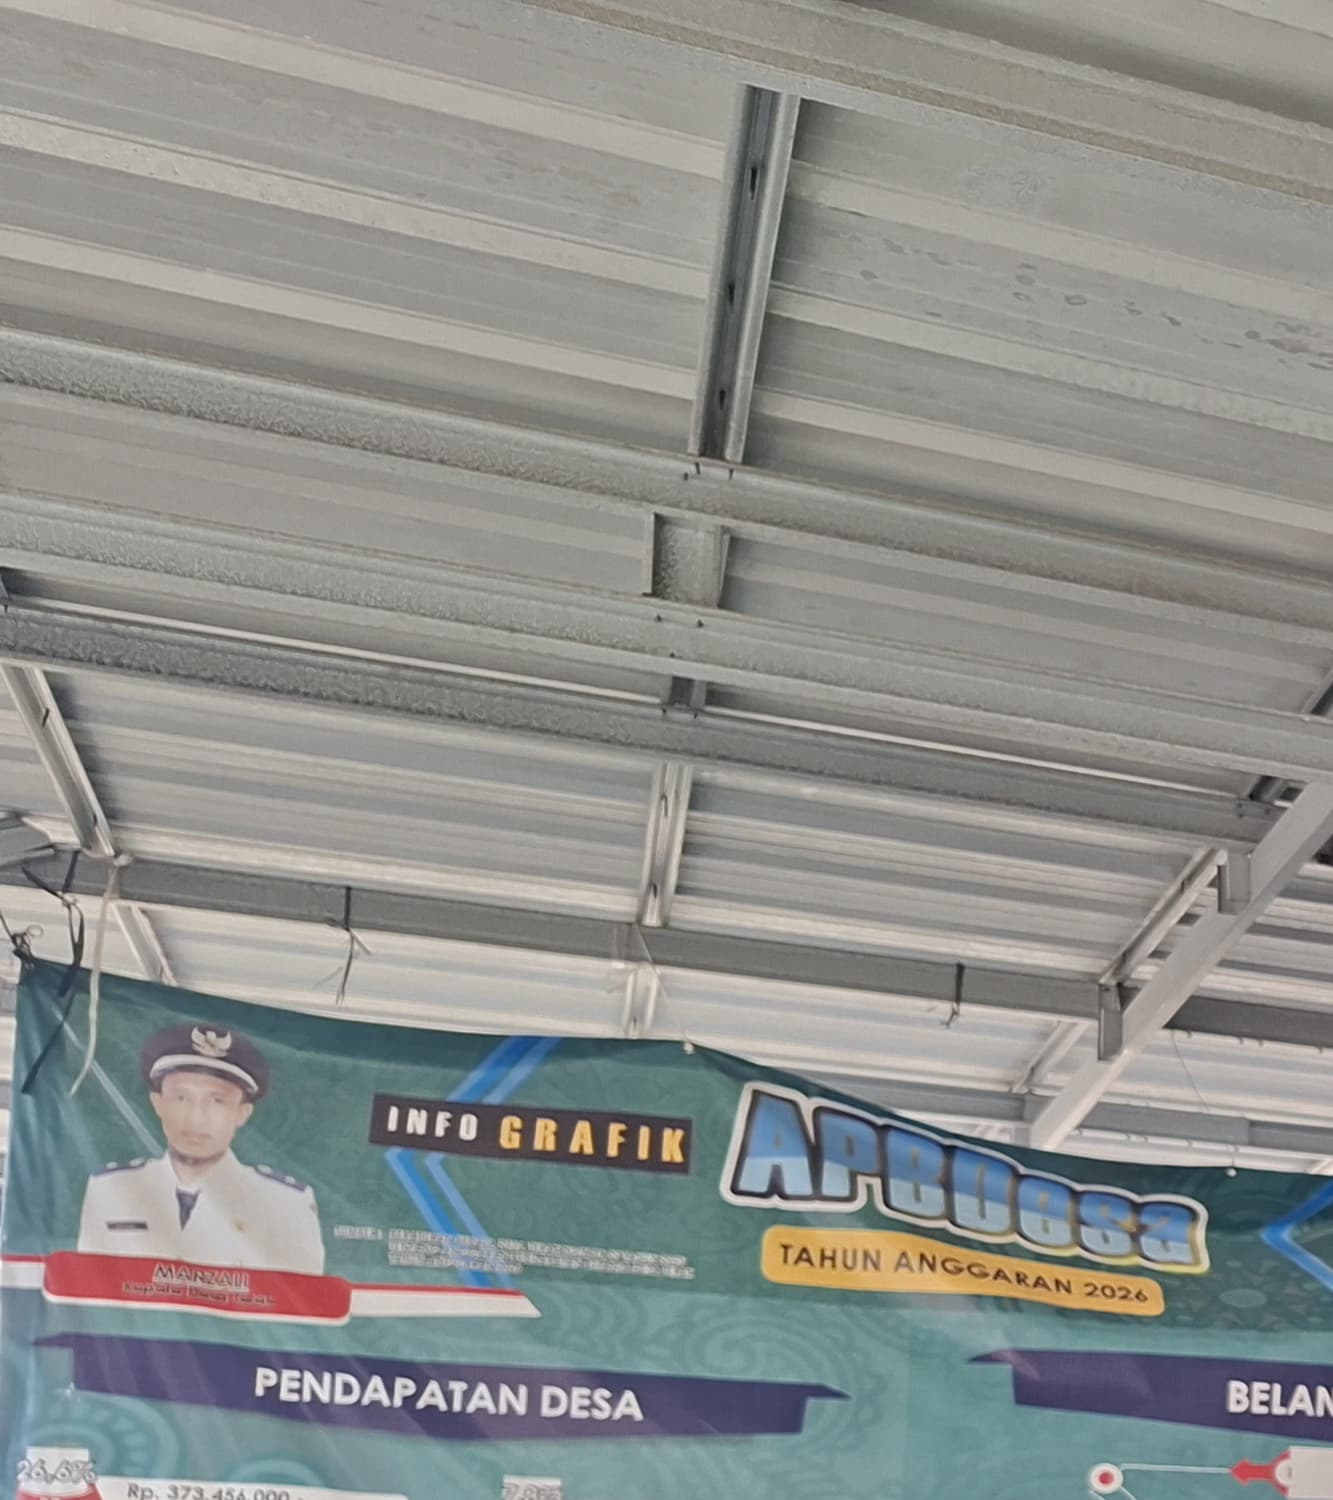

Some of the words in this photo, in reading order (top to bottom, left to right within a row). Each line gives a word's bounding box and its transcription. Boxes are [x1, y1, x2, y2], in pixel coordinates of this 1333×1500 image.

[387, 1105, 478, 1141] INFO
[500, 1115, 685, 1163] GRAFIK
[780, 1242, 881, 1273] TAHUN
[899, 1249, 1072, 1295] ANGGARAN
[1083, 1281, 1149, 1303] 2026
[256, 1367, 527, 1416] PENDAPATAN
[540, 1386, 644, 1421] DESA
